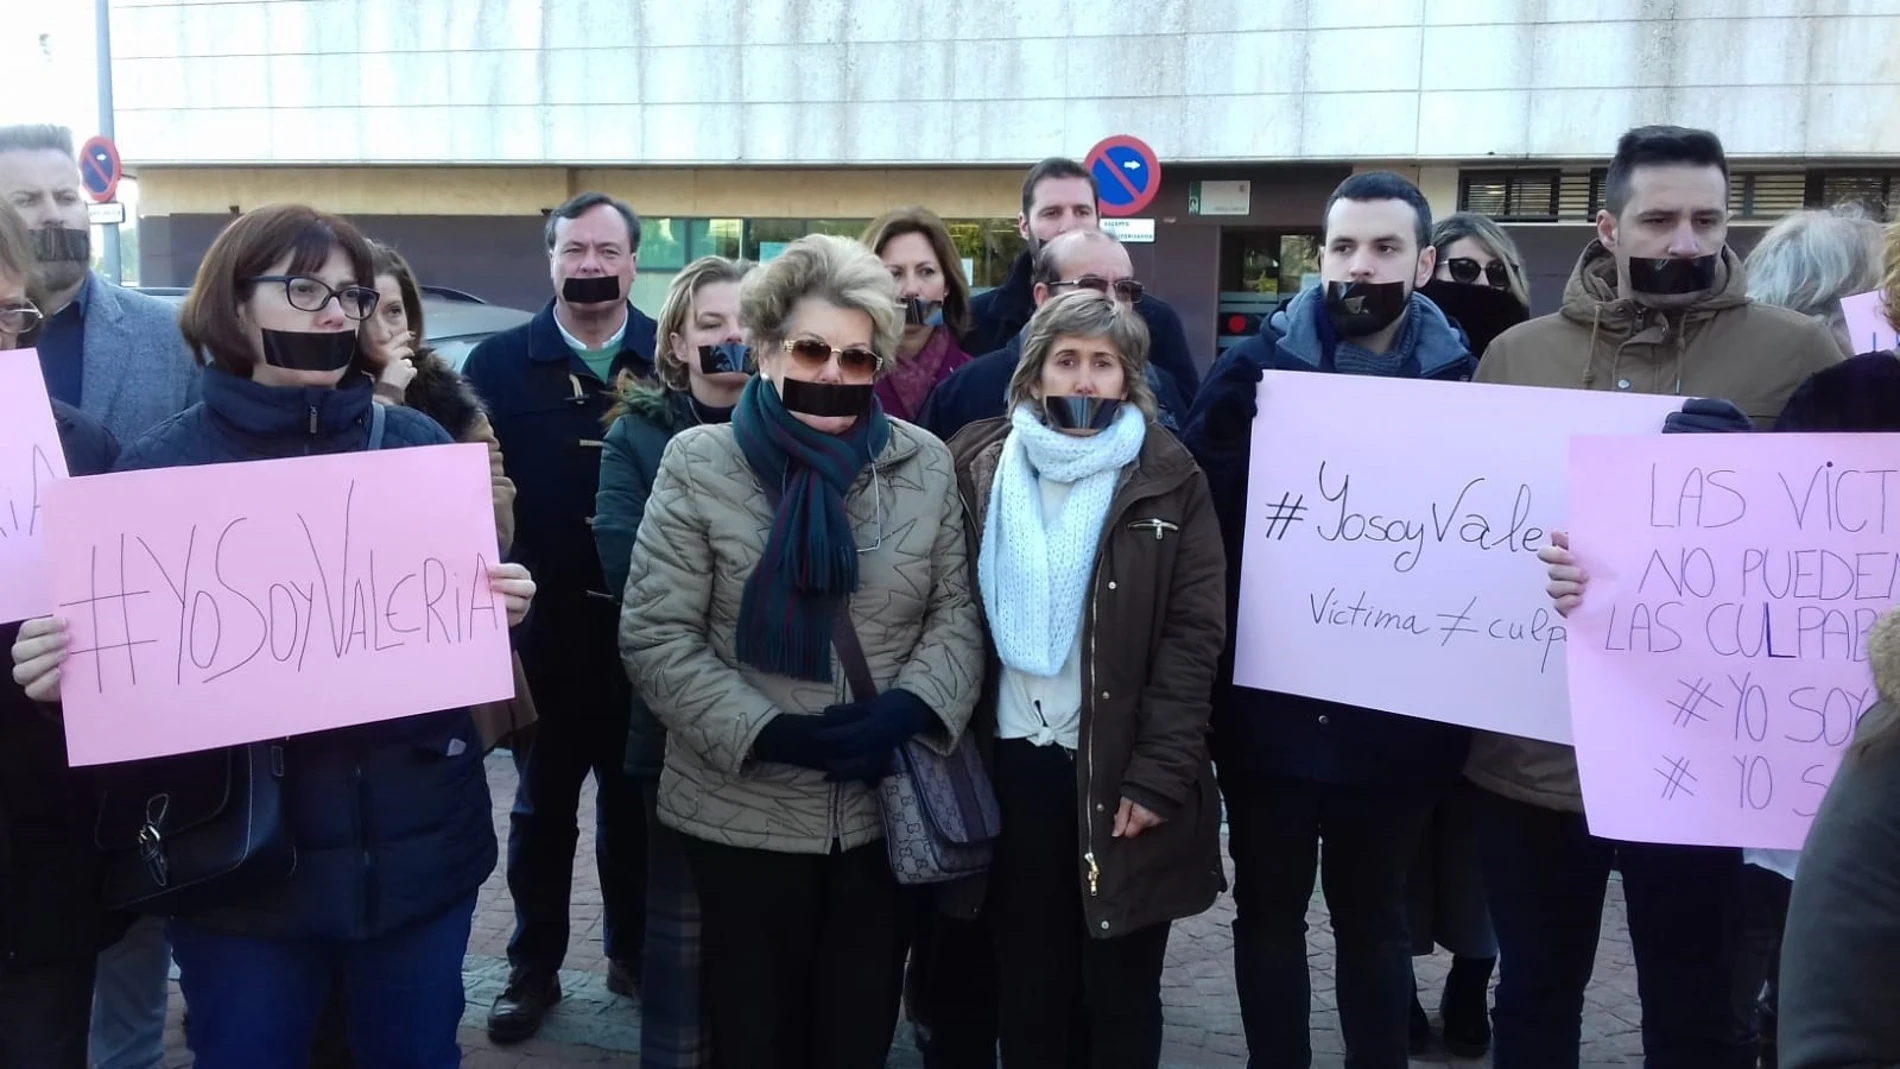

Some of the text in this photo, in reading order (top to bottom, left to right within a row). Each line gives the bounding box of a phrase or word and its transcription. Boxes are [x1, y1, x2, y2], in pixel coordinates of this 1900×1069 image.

[1650, 463, 1746, 529] LAS
[1638, 546, 1716, 598] NO
[1604, 601, 1685, 653] LAS
[1732, 755, 1773, 810] YO
